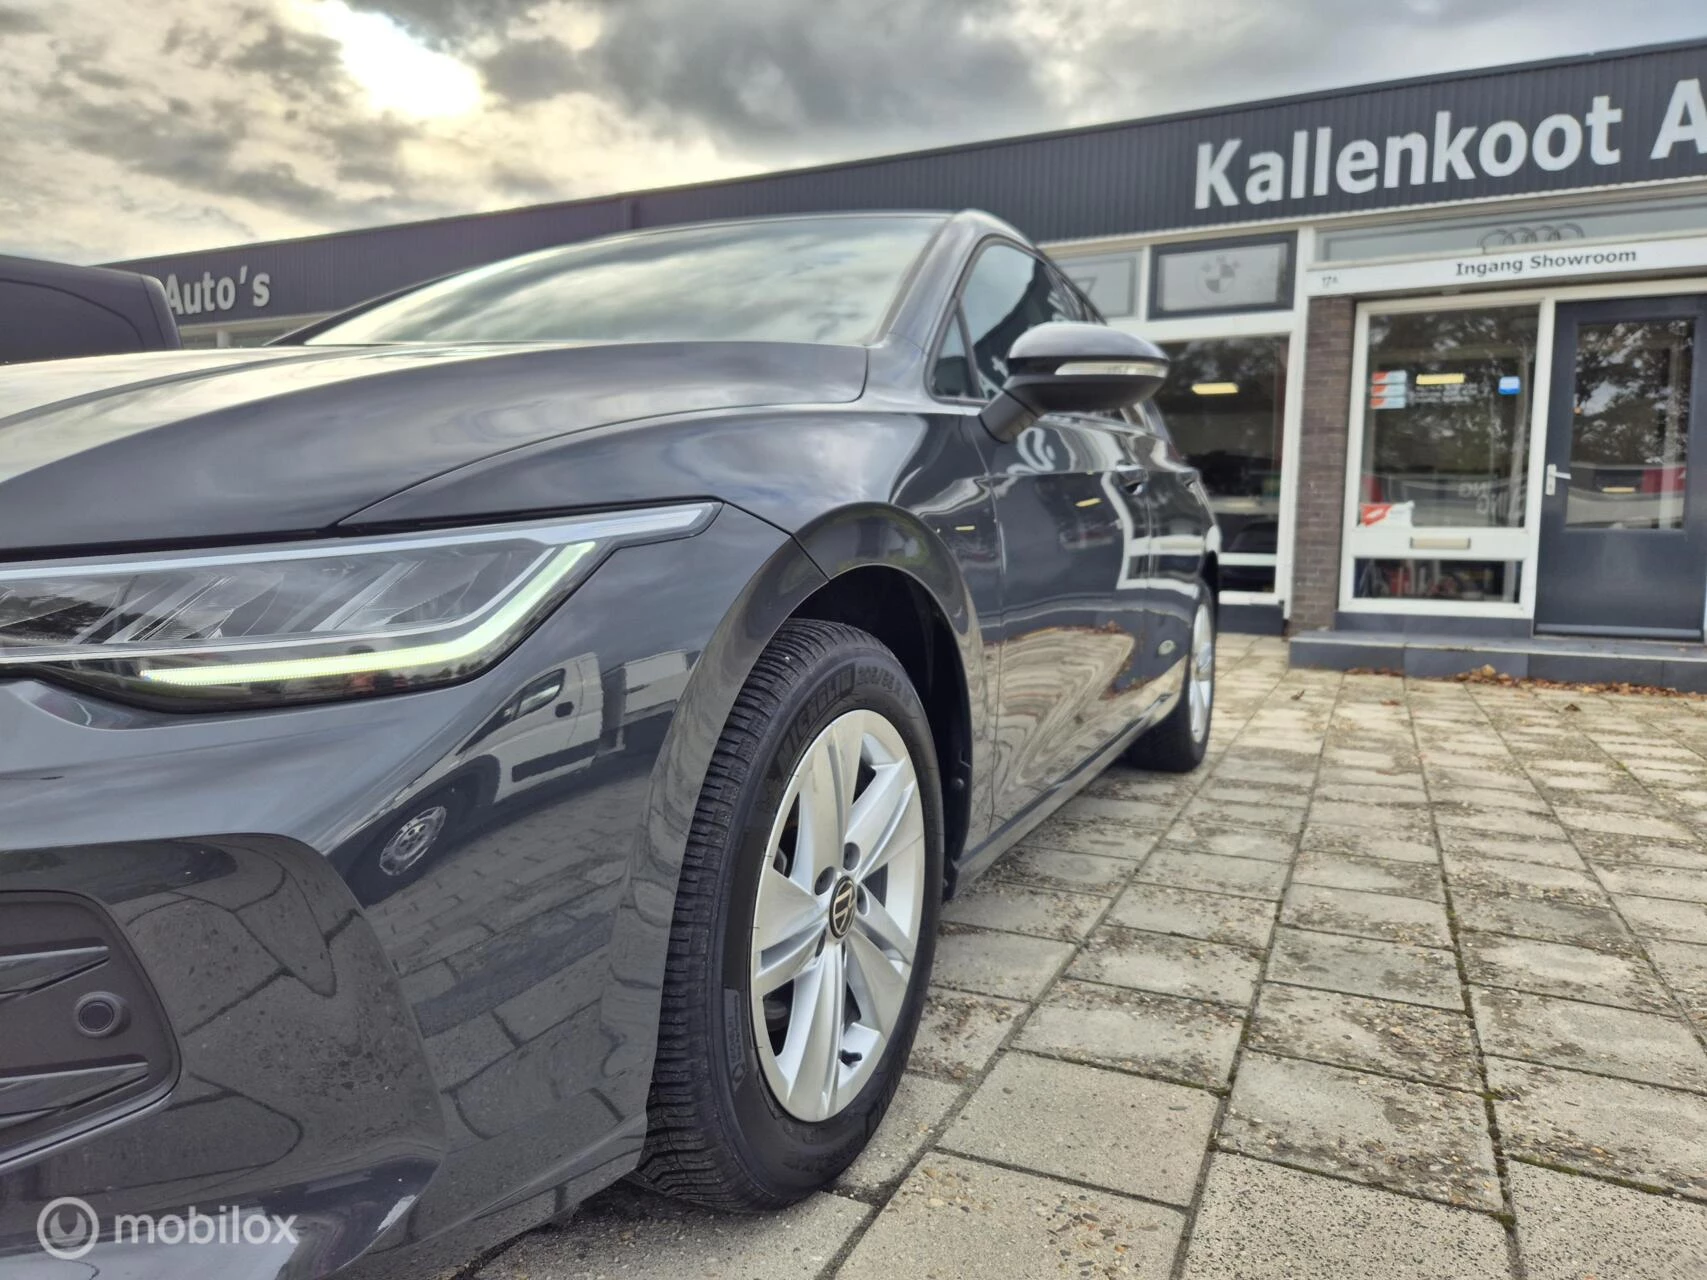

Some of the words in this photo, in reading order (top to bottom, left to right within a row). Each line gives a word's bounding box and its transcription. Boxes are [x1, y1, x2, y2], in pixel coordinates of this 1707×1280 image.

[1194, 96, 1623, 210] Kallenkoot
[164, 264, 271, 315] Auto's
[1456, 257, 1523, 278] Ingang
[1530, 250, 1637, 270] Showroom
